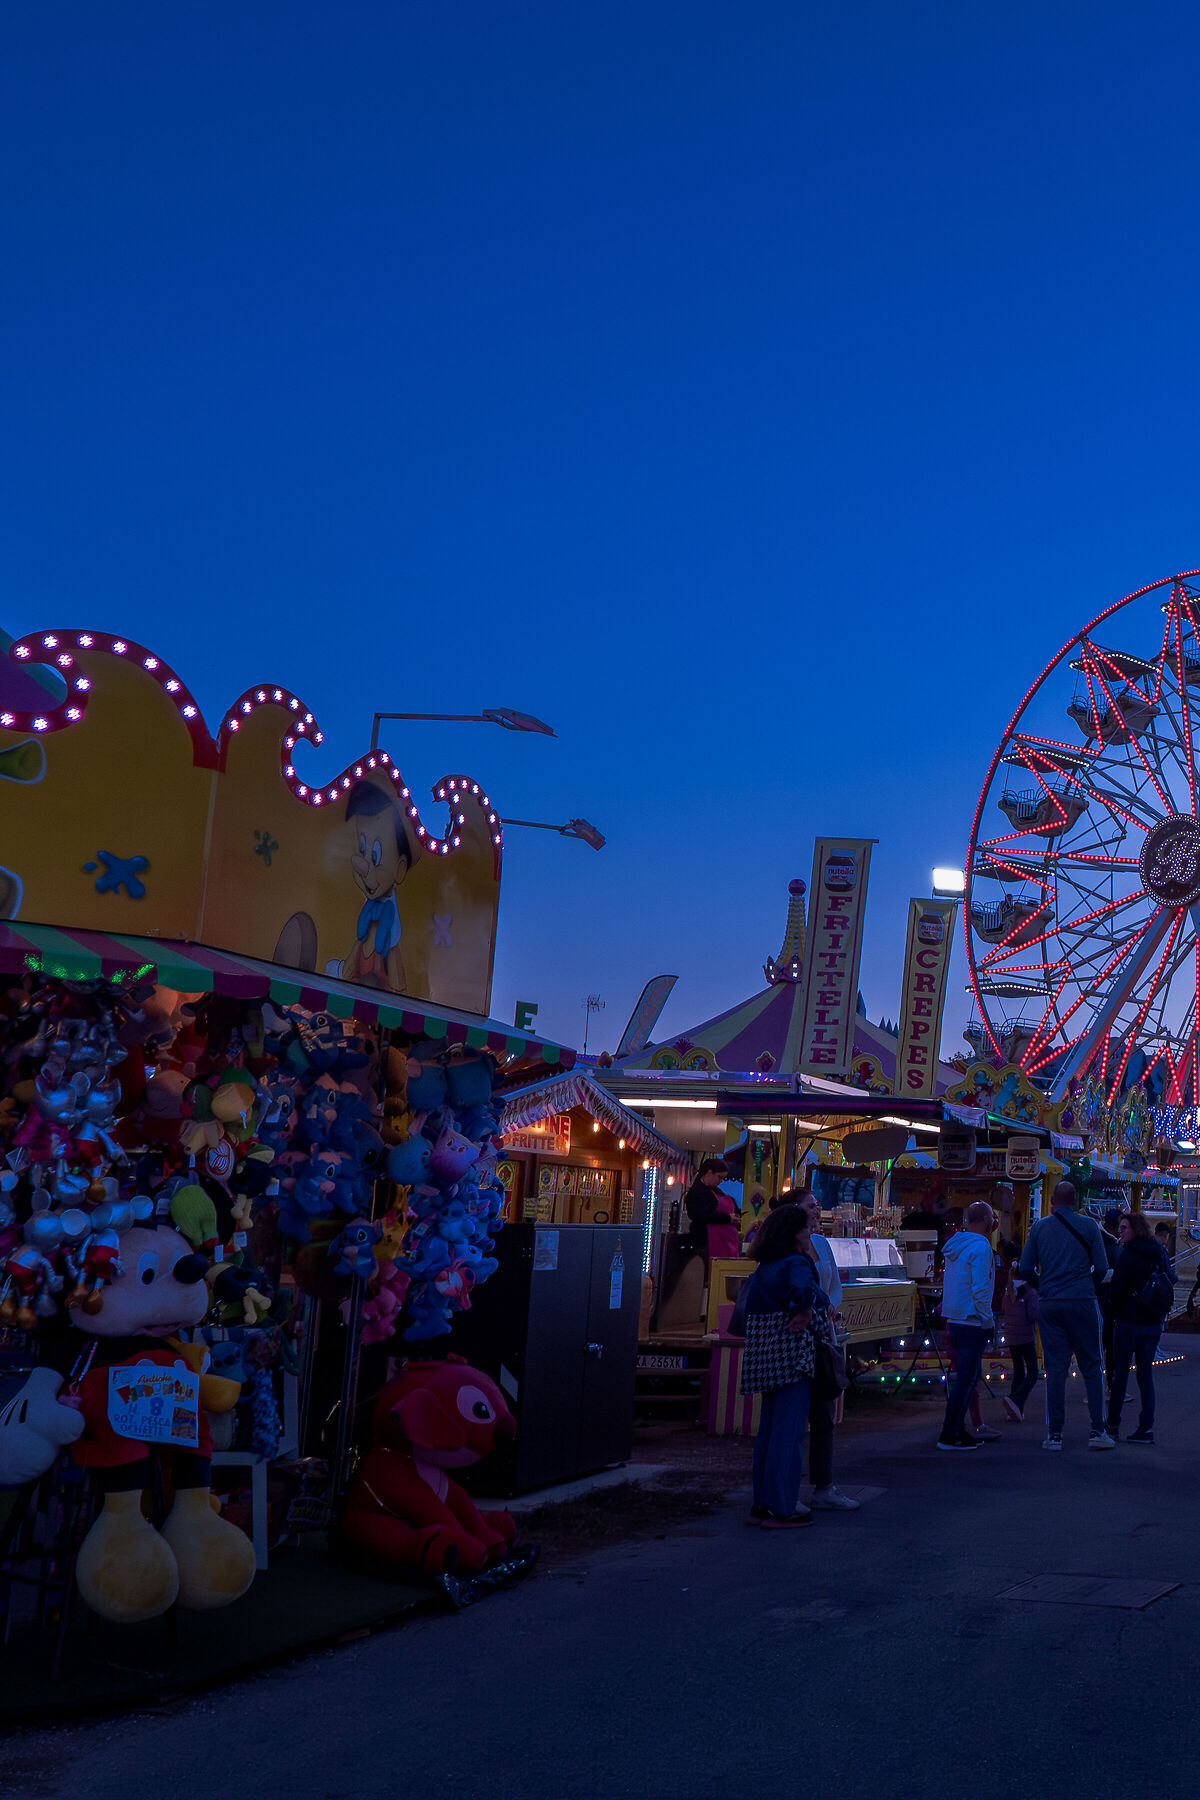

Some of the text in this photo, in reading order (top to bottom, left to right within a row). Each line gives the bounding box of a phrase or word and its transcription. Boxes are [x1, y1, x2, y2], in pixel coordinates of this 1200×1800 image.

[809, 896, 852, 1064] FRITTELLE
[906, 949, 941, 1089] CREPES
[512, 1133, 554, 1151] FRITTE
[1010, 1156, 1037, 1164] nutella
[150, 1397, 164, 1416] 8
[142, 1415, 170, 1427] PESCA
